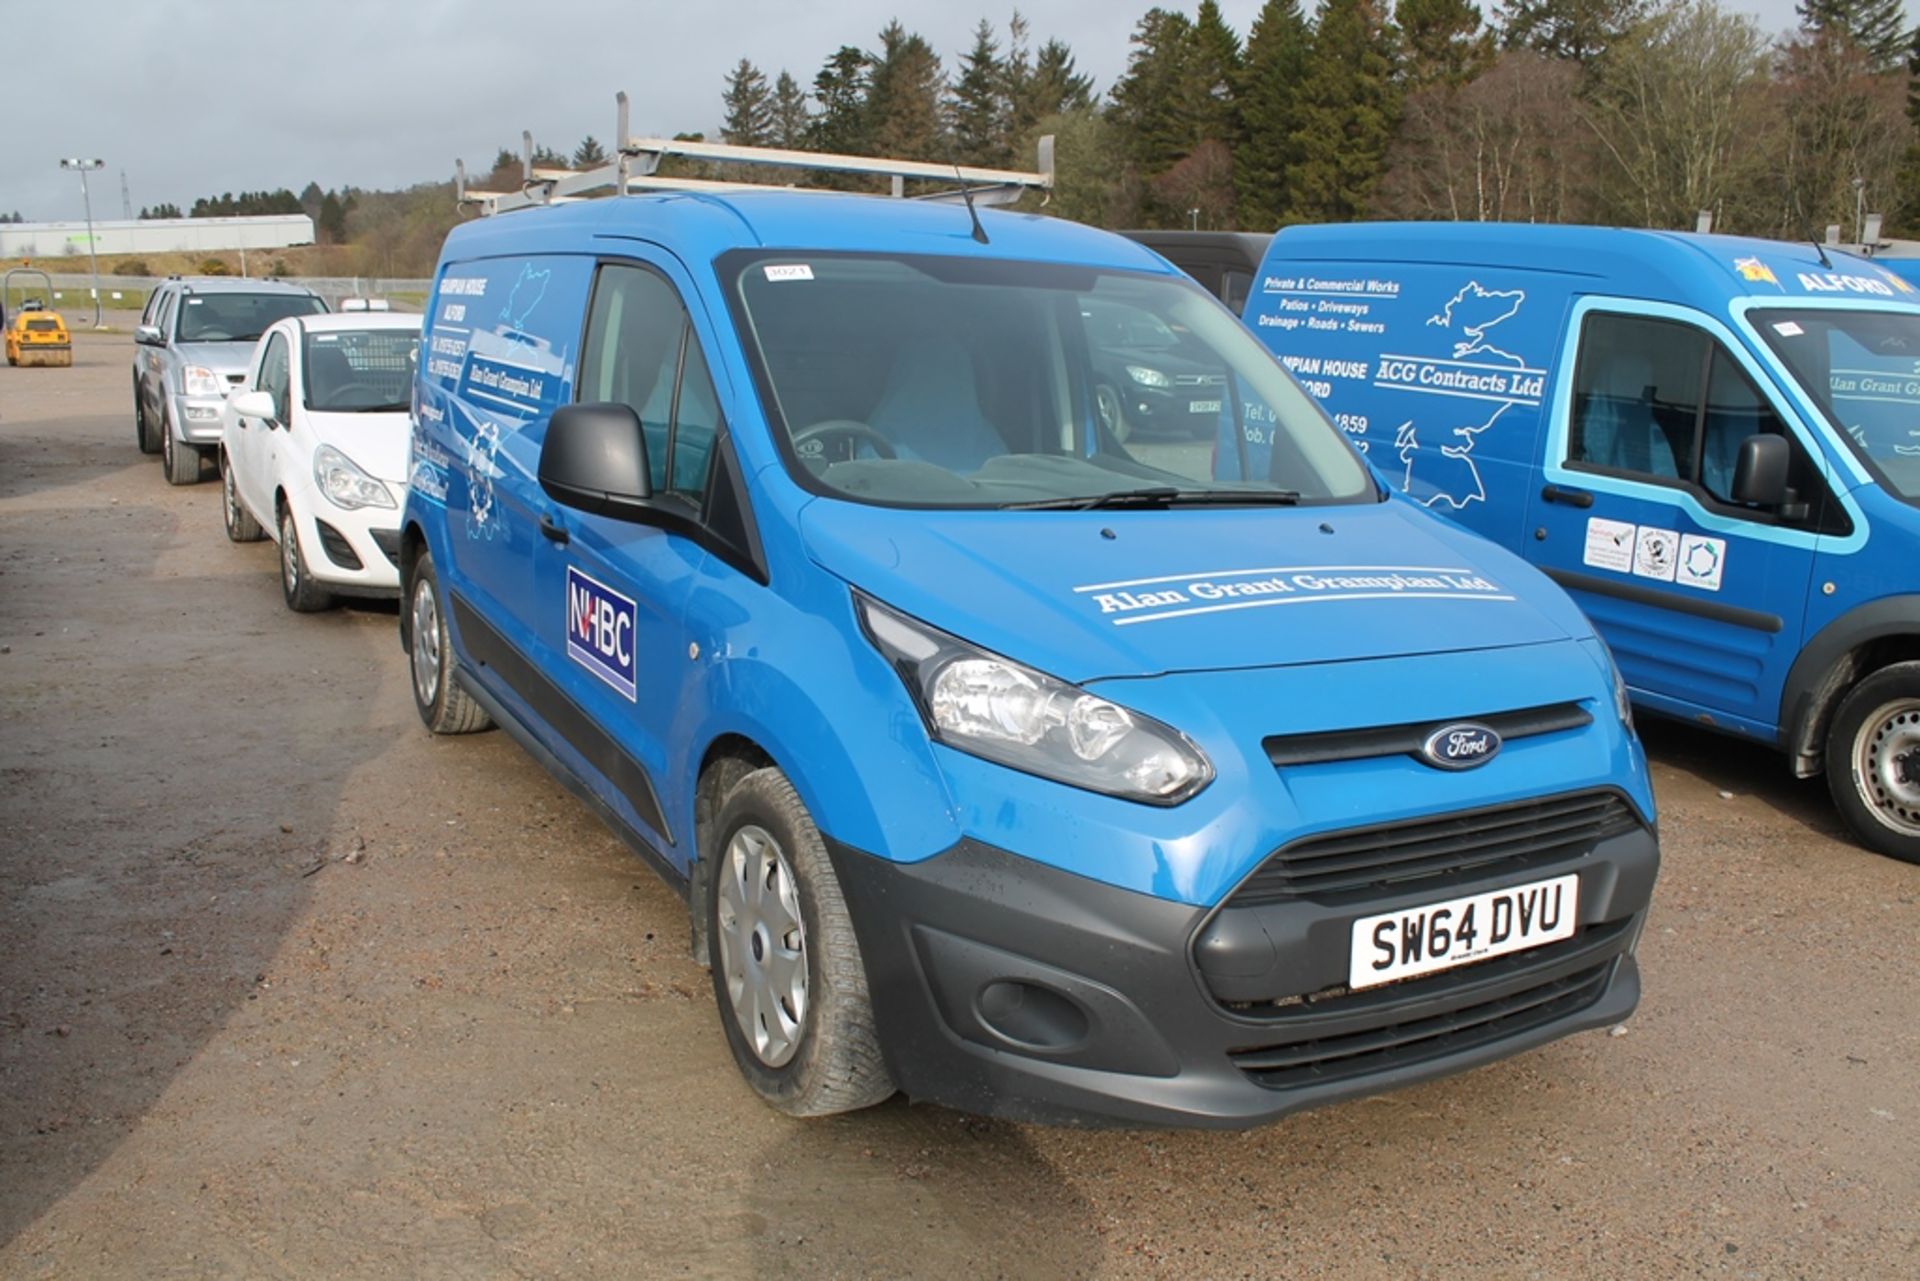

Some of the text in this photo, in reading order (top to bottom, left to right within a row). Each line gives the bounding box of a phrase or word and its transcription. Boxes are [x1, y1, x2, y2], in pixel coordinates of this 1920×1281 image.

[1263, 277, 1400, 293] Private & Commercial Works
[1797, 273, 1894, 296] ALFORD
[1280, 298, 1369, 317] Patios Driveways
[1258, 314, 1385, 334] Drainage Roads Sewers
[1321, 359, 1368, 379] HOUSE
[1375, 360, 1544, 397] ACG Contracts Ltd
[483, 367, 498, 388] Grant
[499, 371, 529, 397] Grampian
[1860, 378, 1901, 393] Grant
[1244, 402, 1265, 421] Tel.
[1244, 425, 1265, 444] ob.
[1092, 591, 1190, 614] Alan
[1188, 577, 1296, 600] Grant
[1291, 573, 1450, 592] Grampian
[571, 581, 631, 668] NHBC
[1447, 731, 1487, 757] Ford
[1371, 884, 1562, 971] SW64 DVU
